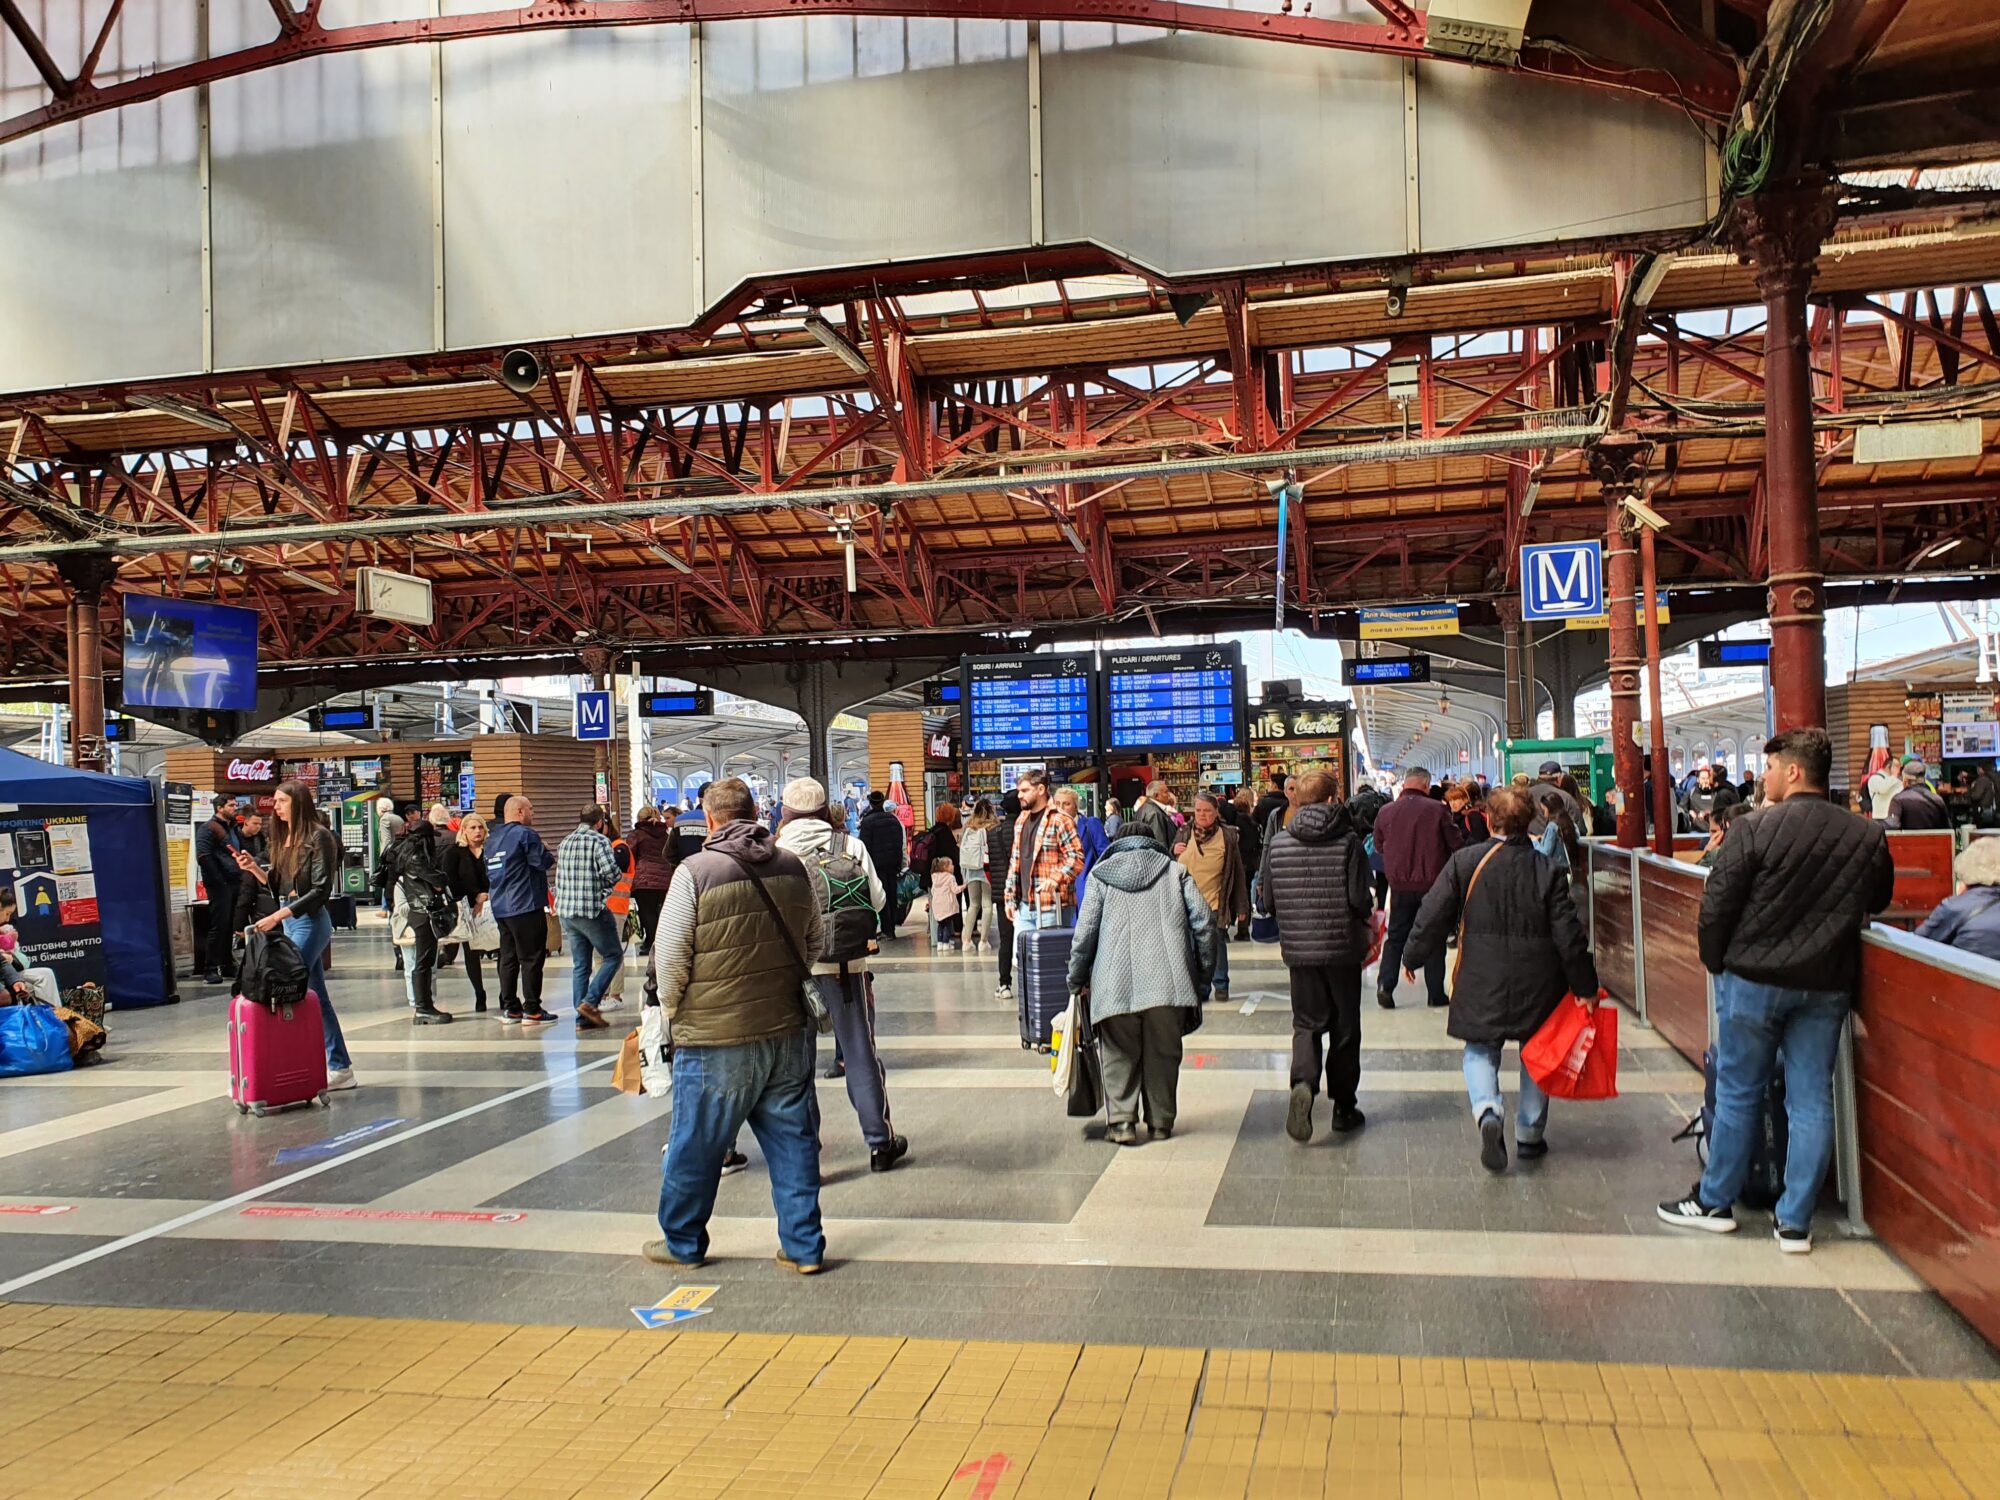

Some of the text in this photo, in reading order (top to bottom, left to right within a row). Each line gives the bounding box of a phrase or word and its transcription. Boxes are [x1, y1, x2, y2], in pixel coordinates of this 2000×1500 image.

[1538, 550, 1588, 601] M
[1142, 654, 1181, 662] DEPARTURES
[994, 662, 1022, 670] ARRIVALS
[581, 700, 604, 724] M
[70, 937, 102, 947] житло
[40, 948, 85, 962] біженців
